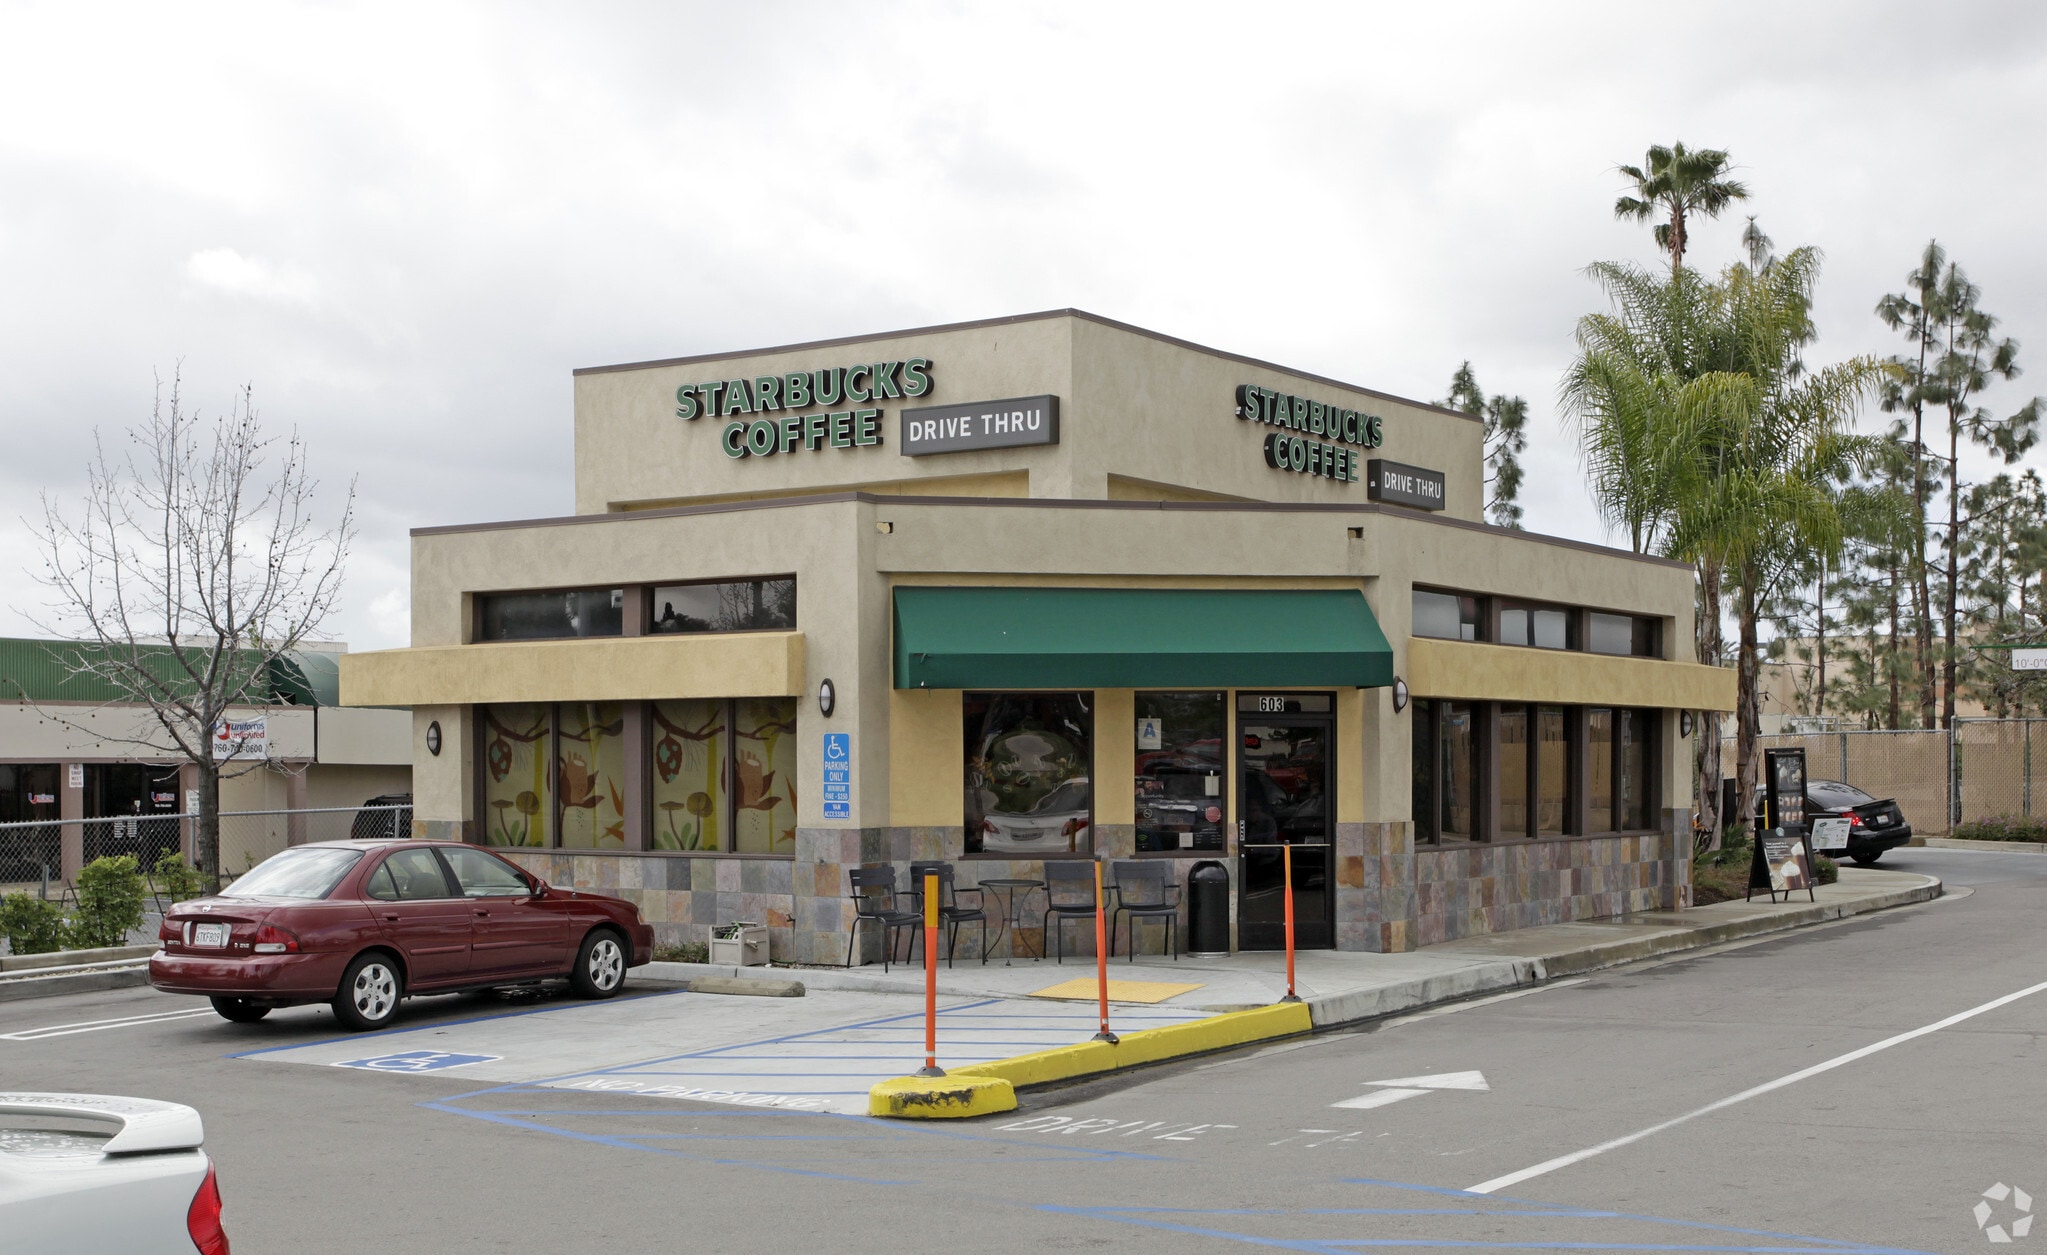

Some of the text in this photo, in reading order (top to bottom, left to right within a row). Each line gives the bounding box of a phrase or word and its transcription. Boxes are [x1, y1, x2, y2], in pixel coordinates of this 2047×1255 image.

[675, 356, 931, 421] STARBUCKS
[909, 409, 1041, 442] DRIVE THRU
[1239, 383, 1384, 449] STARBUCKS
[721, 407, 881, 460] COFFEE
[1269, 431, 1361, 483] COFFEE
[1384, 471, 1442, 499] DRIVE THRU
[1260, 697, 1283, 711] 603
[1143, 722, 1156, 738] A
[824, 761, 848, 770] PARKING
[830, 772, 844, 782] ONLY
[992, 1115, 1240, 1141] DRIVE
